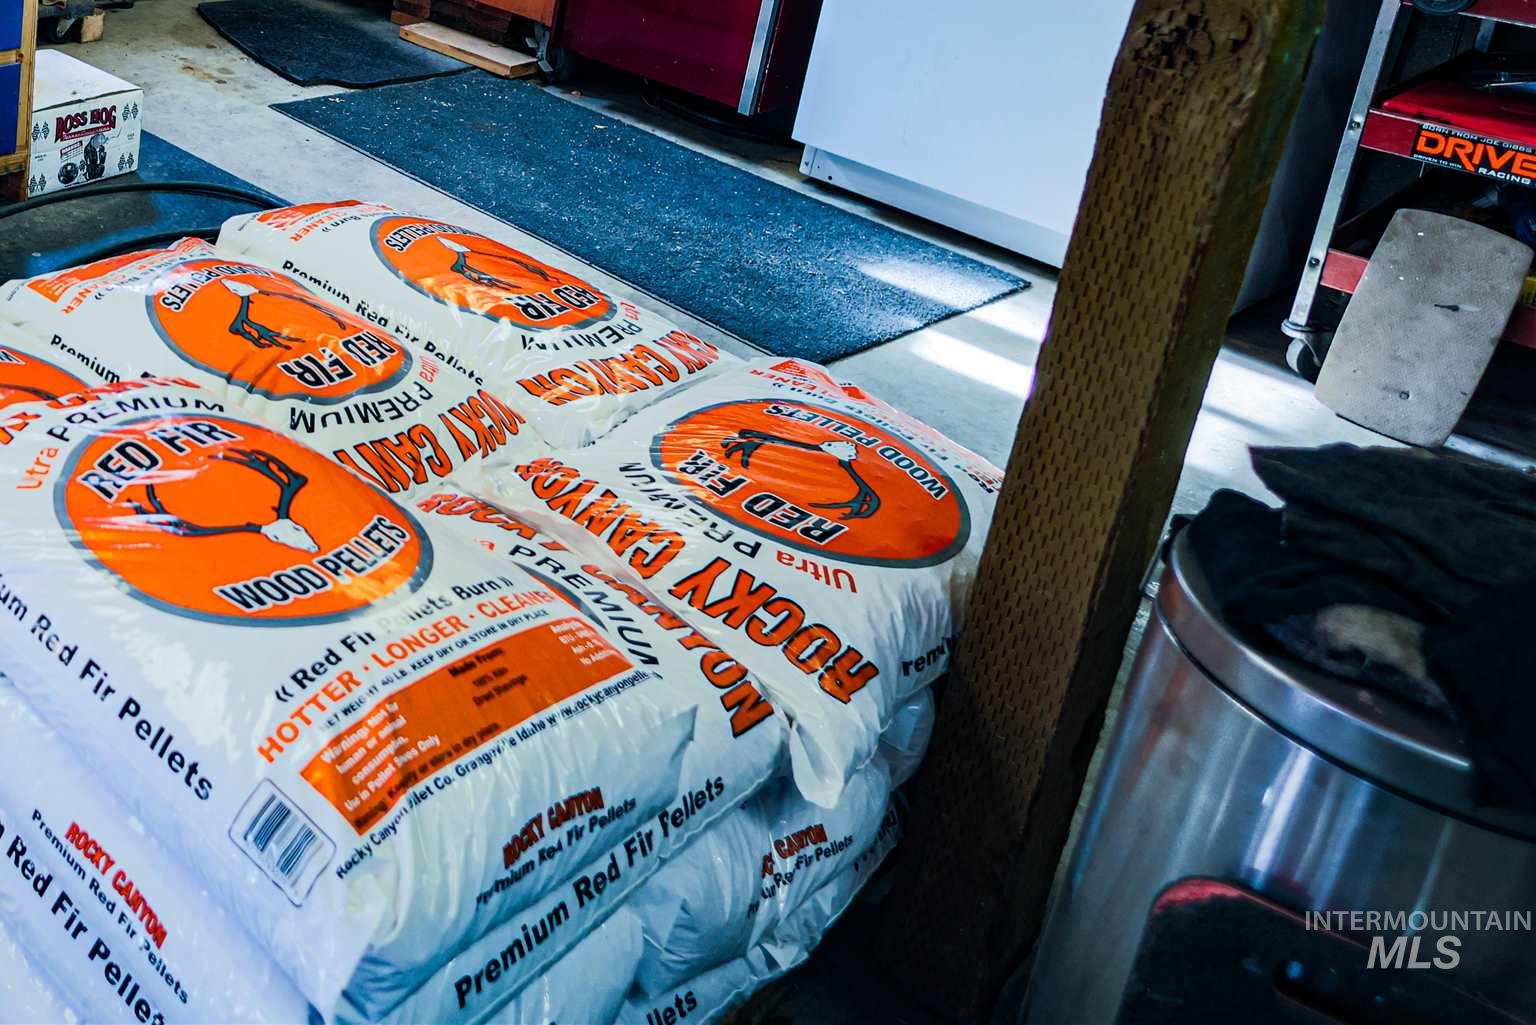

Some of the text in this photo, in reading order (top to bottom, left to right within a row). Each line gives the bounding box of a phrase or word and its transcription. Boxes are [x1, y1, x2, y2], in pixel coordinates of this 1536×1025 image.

[55, 110, 88, 143] BOSS
[90, 105, 117, 129] HOG
[1422, 122, 1533, 153] BORN FROM JOE GIBBS
[1478, 167, 1532, 185] RACING
[50, 334, 121, 384] Premium
[280, 331, 398, 387] RED FIR
[47, 397, 225, 443] PREMIUM
[289, 381, 434, 433] PREMIUM
[80, 423, 235, 498] RED FIR
[764, 404, 950, 501] WOOD PELLETS
[743, 493, 848, 544] RED
[221, 517, 408, 611] WOOD PELLETS
[516, 457, 880, 705] ROCKY CANYON
[775, 550, 858, 594] Ultra
[289, 644, 343, 691] Red
[454, 579, 499, 601] Burn
[410, 654, 435, 672] KEEP
[469, 626, 498, 644] STORE
[524, 609, 550, 622] PLACE
[509, 544, 661, 667] PREMIUM
[31, 614, 79, 666] Red
[79, 658, 116, 705] Fir
[118, 697, 213, 802] Pellets
[256, 589, 556, 765] HOTTER LONGER CLEANER
[335, 842, 374, 880] Rocky
[433, 773, 454, 794] Co.
[502, 786, 605, 869] ROCKY CANYON
[564, 825, 587, 852] Fir
[587, 795, 637, 832] Pellets
[814, 832, 855, 864] Pellets
[6, 836, 52, 900] Red
[51, 888, 89, 941] Fir
[31, 808, 190, 1005] Premium Red Fir Pellets
[65, 821, 169, 951] ROCKY CANYON
[454, 775, 726, 1010] Premium Red Fir Pellets
